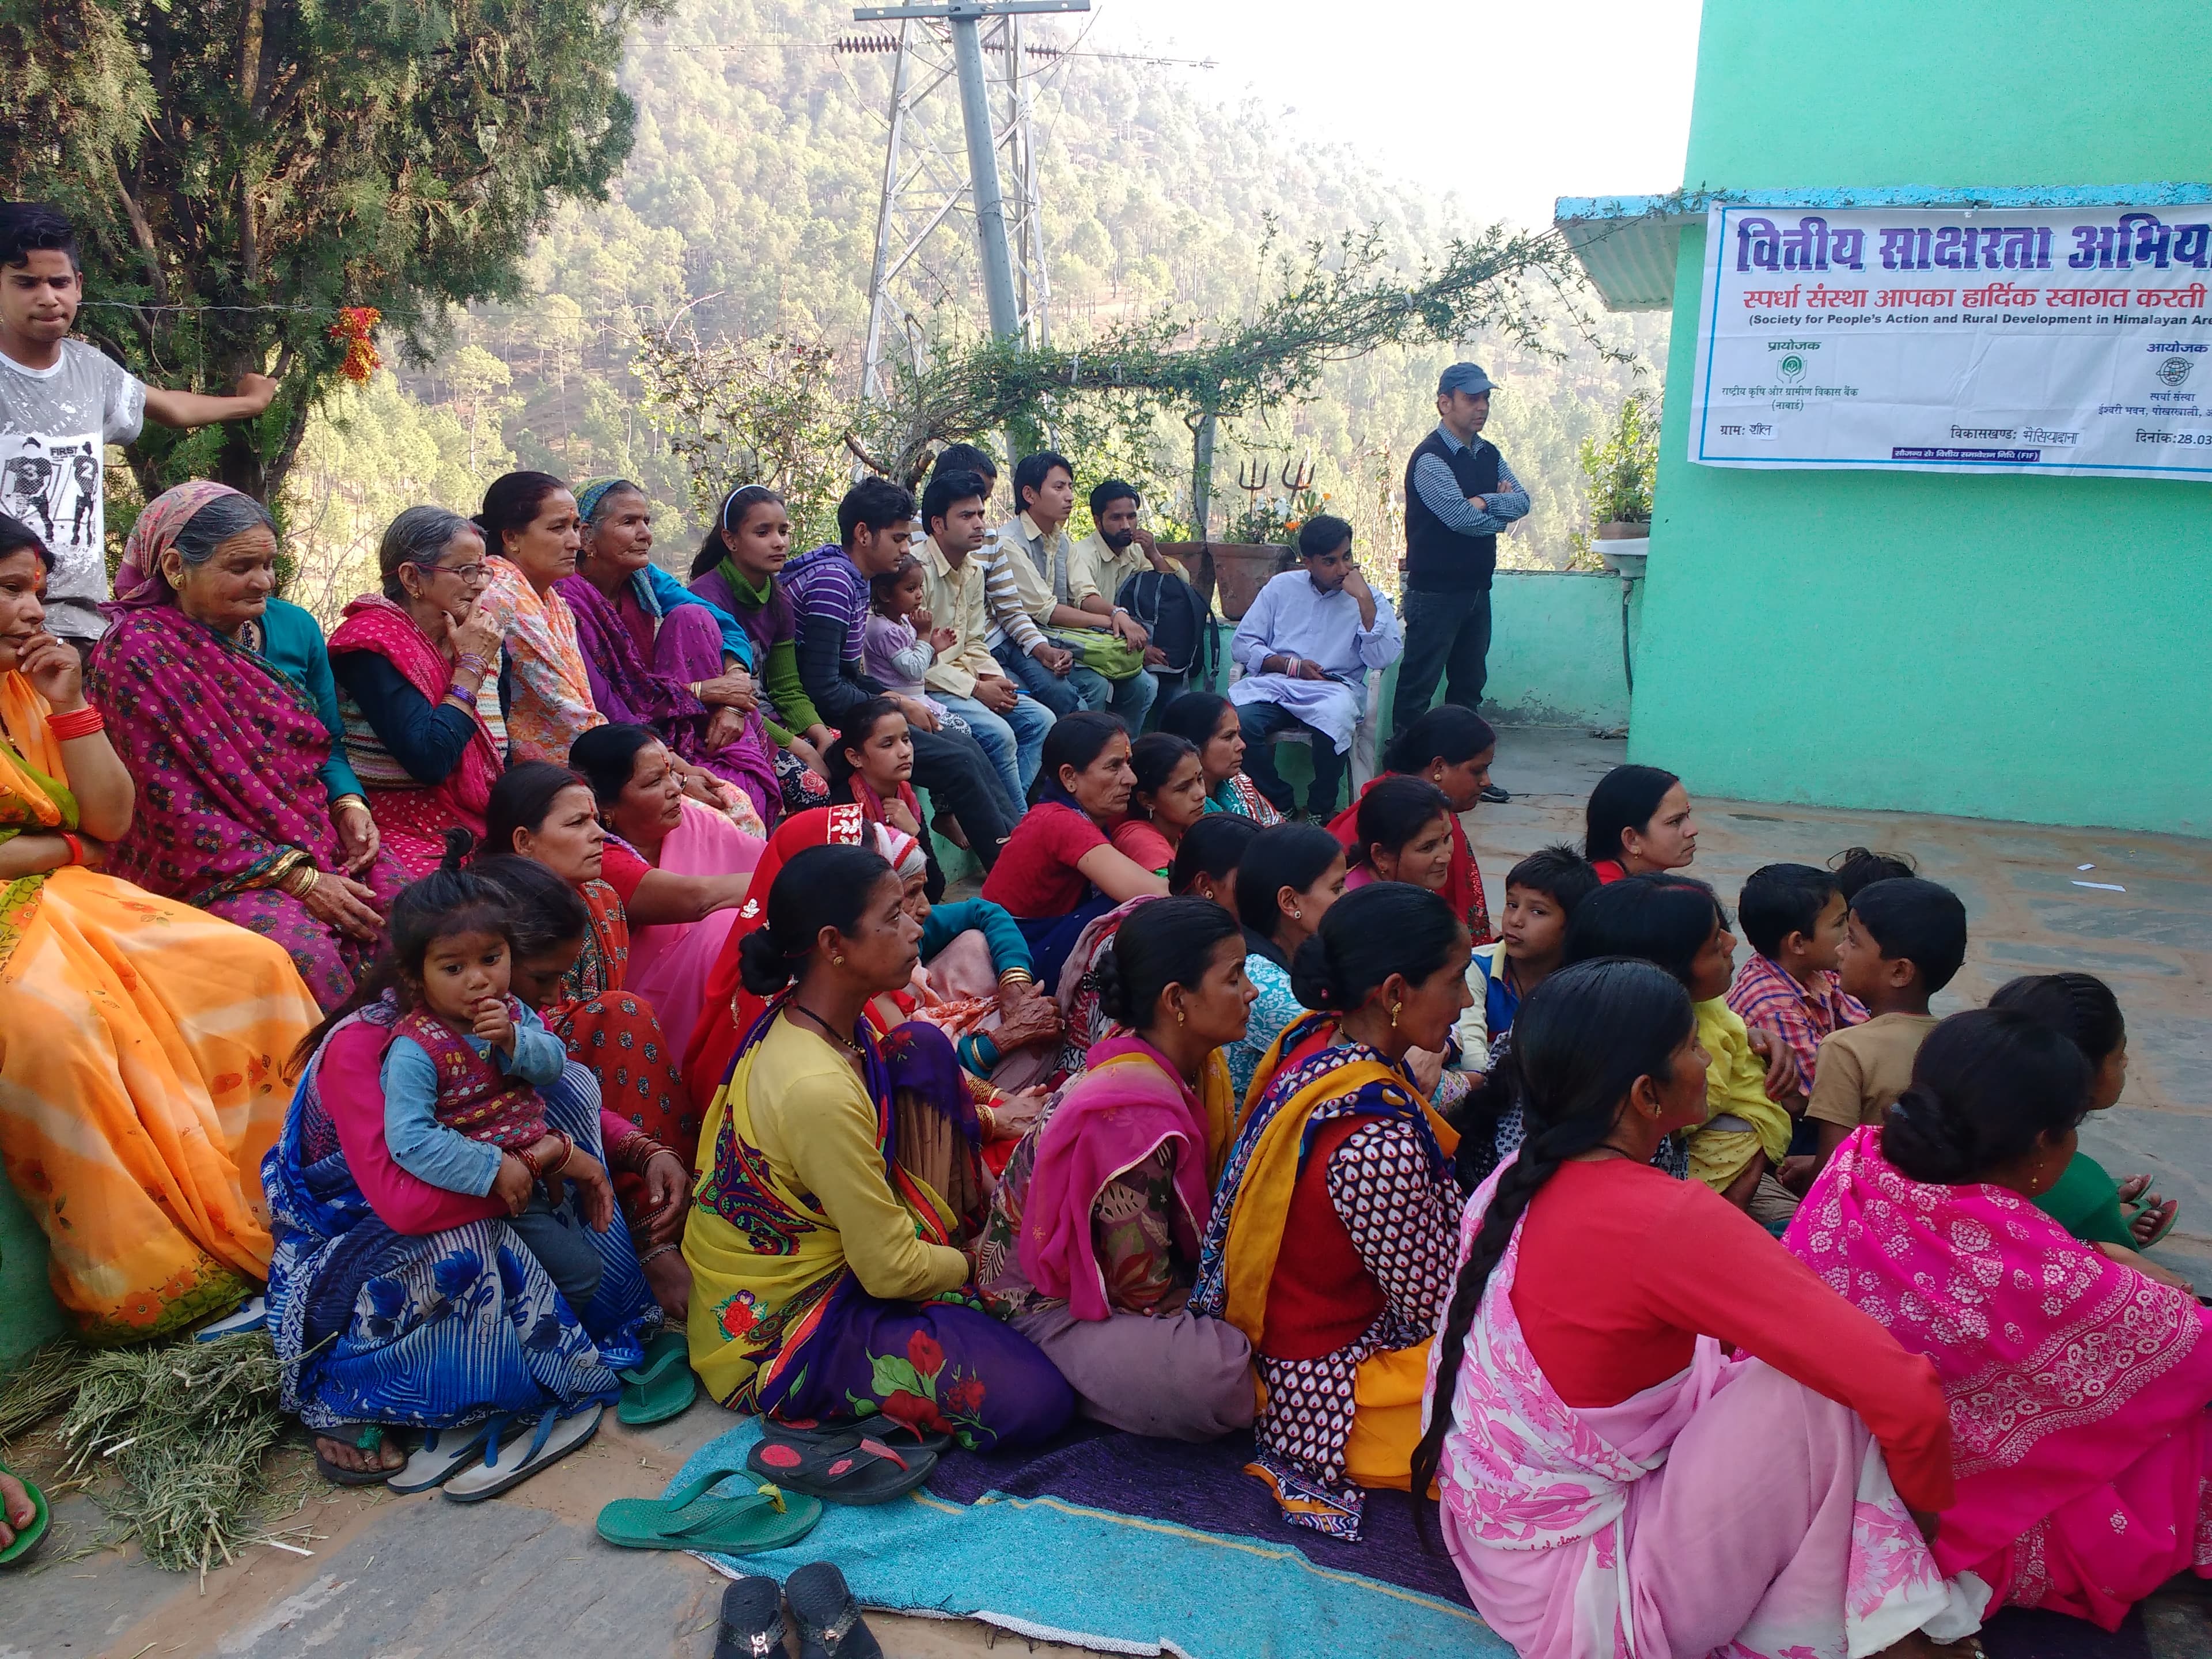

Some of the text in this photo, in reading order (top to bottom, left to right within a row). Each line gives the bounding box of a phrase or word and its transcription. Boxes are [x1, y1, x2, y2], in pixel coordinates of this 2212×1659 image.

[1736, 213, 2212, 272] वित्तीय साक्षरता अभिय
[1743, 282, 2207, 308] स्पर्धा संस्था आपका हार्दिक स्वागत करती
[1749, 313, 2212, 327] (Society for People's Action and Rural Development in Himalayan Are
[1768, 339, 1821, 352] प्रायोजक
[2146, 340, 2210, 353] आयोजक
[1722, 385, 1747, 397] राष्ट्रीय
[1748, 385, 1766, 398] कृषि
[1768, 385, 1784, 396] और
[1785, 385, 1814, 396] ग्रामीण
[1815, 385, 1843, 396] विकास
[2149, 390, 2196, 402] स्पर्धा संस्था
[2177, 434, 2212, 445] 28.03
[50, 445, 78, 457] FIRST
[2017, 451, 2039, 460] (FIF)
[81, 461, 94, 480] 2
